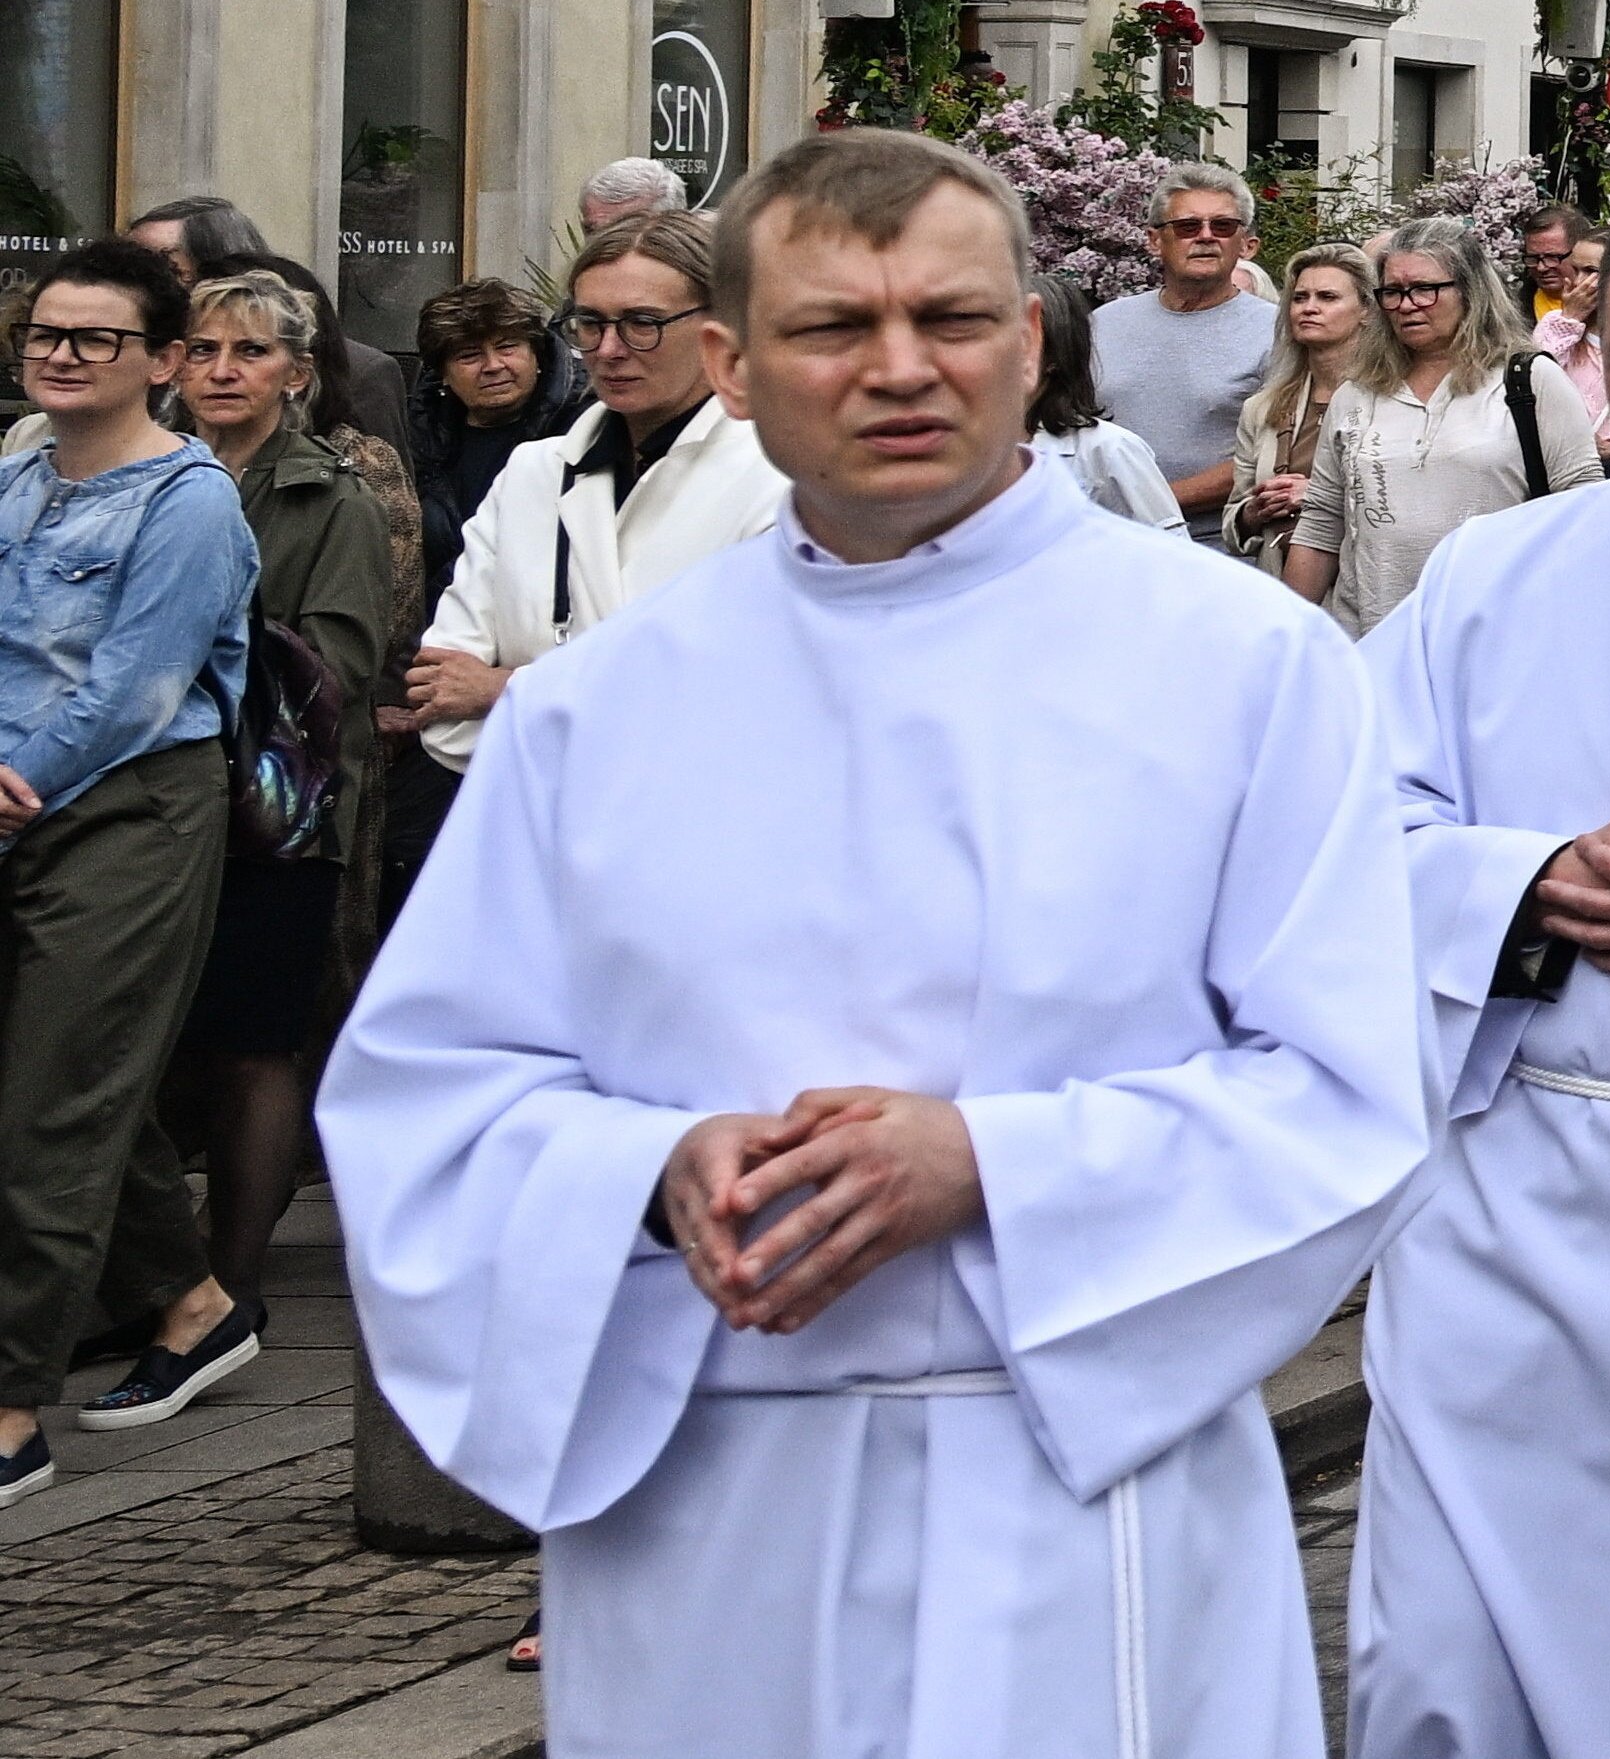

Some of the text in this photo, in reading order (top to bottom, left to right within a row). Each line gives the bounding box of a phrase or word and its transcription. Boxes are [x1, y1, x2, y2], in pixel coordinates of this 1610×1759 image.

[653, 82, 710, 153] SEN
[0, 236, 50, 252] HOTEL
[58, 237, 69, 252] &
[339, 231, 455, 254] SS HOTEL & SPA
